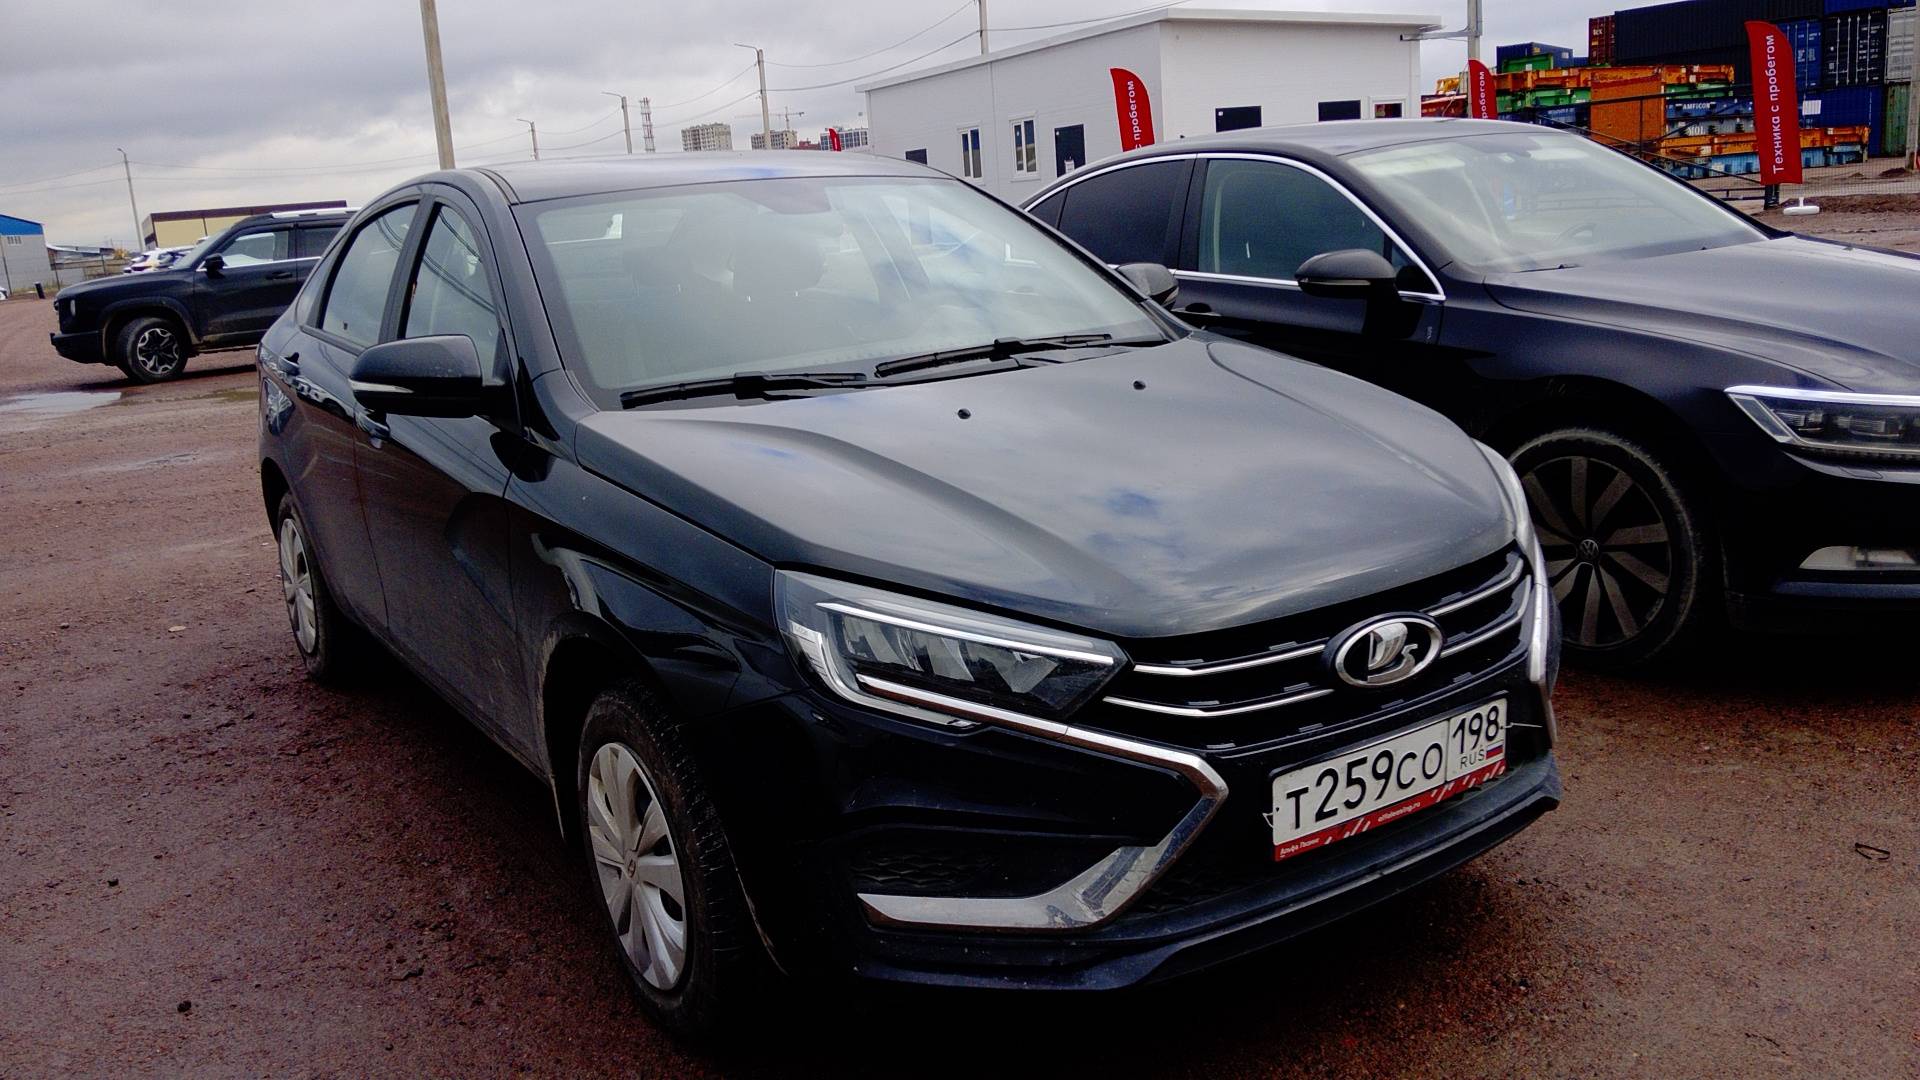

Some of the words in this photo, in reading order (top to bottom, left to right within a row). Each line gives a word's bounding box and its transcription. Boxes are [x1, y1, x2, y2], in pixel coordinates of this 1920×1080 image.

[1765, 34, 1780, 101] пробегом
[1127, 80, 1142, 141] пробегом
[1479, 71, 1489, 119] робегом
[1771, 104, 1780, 112] с
[1771, 116, 1785, 175] Техника
[1452, 705, 1499, 754] 198
[1460, 749, 1485, 769] RUS
